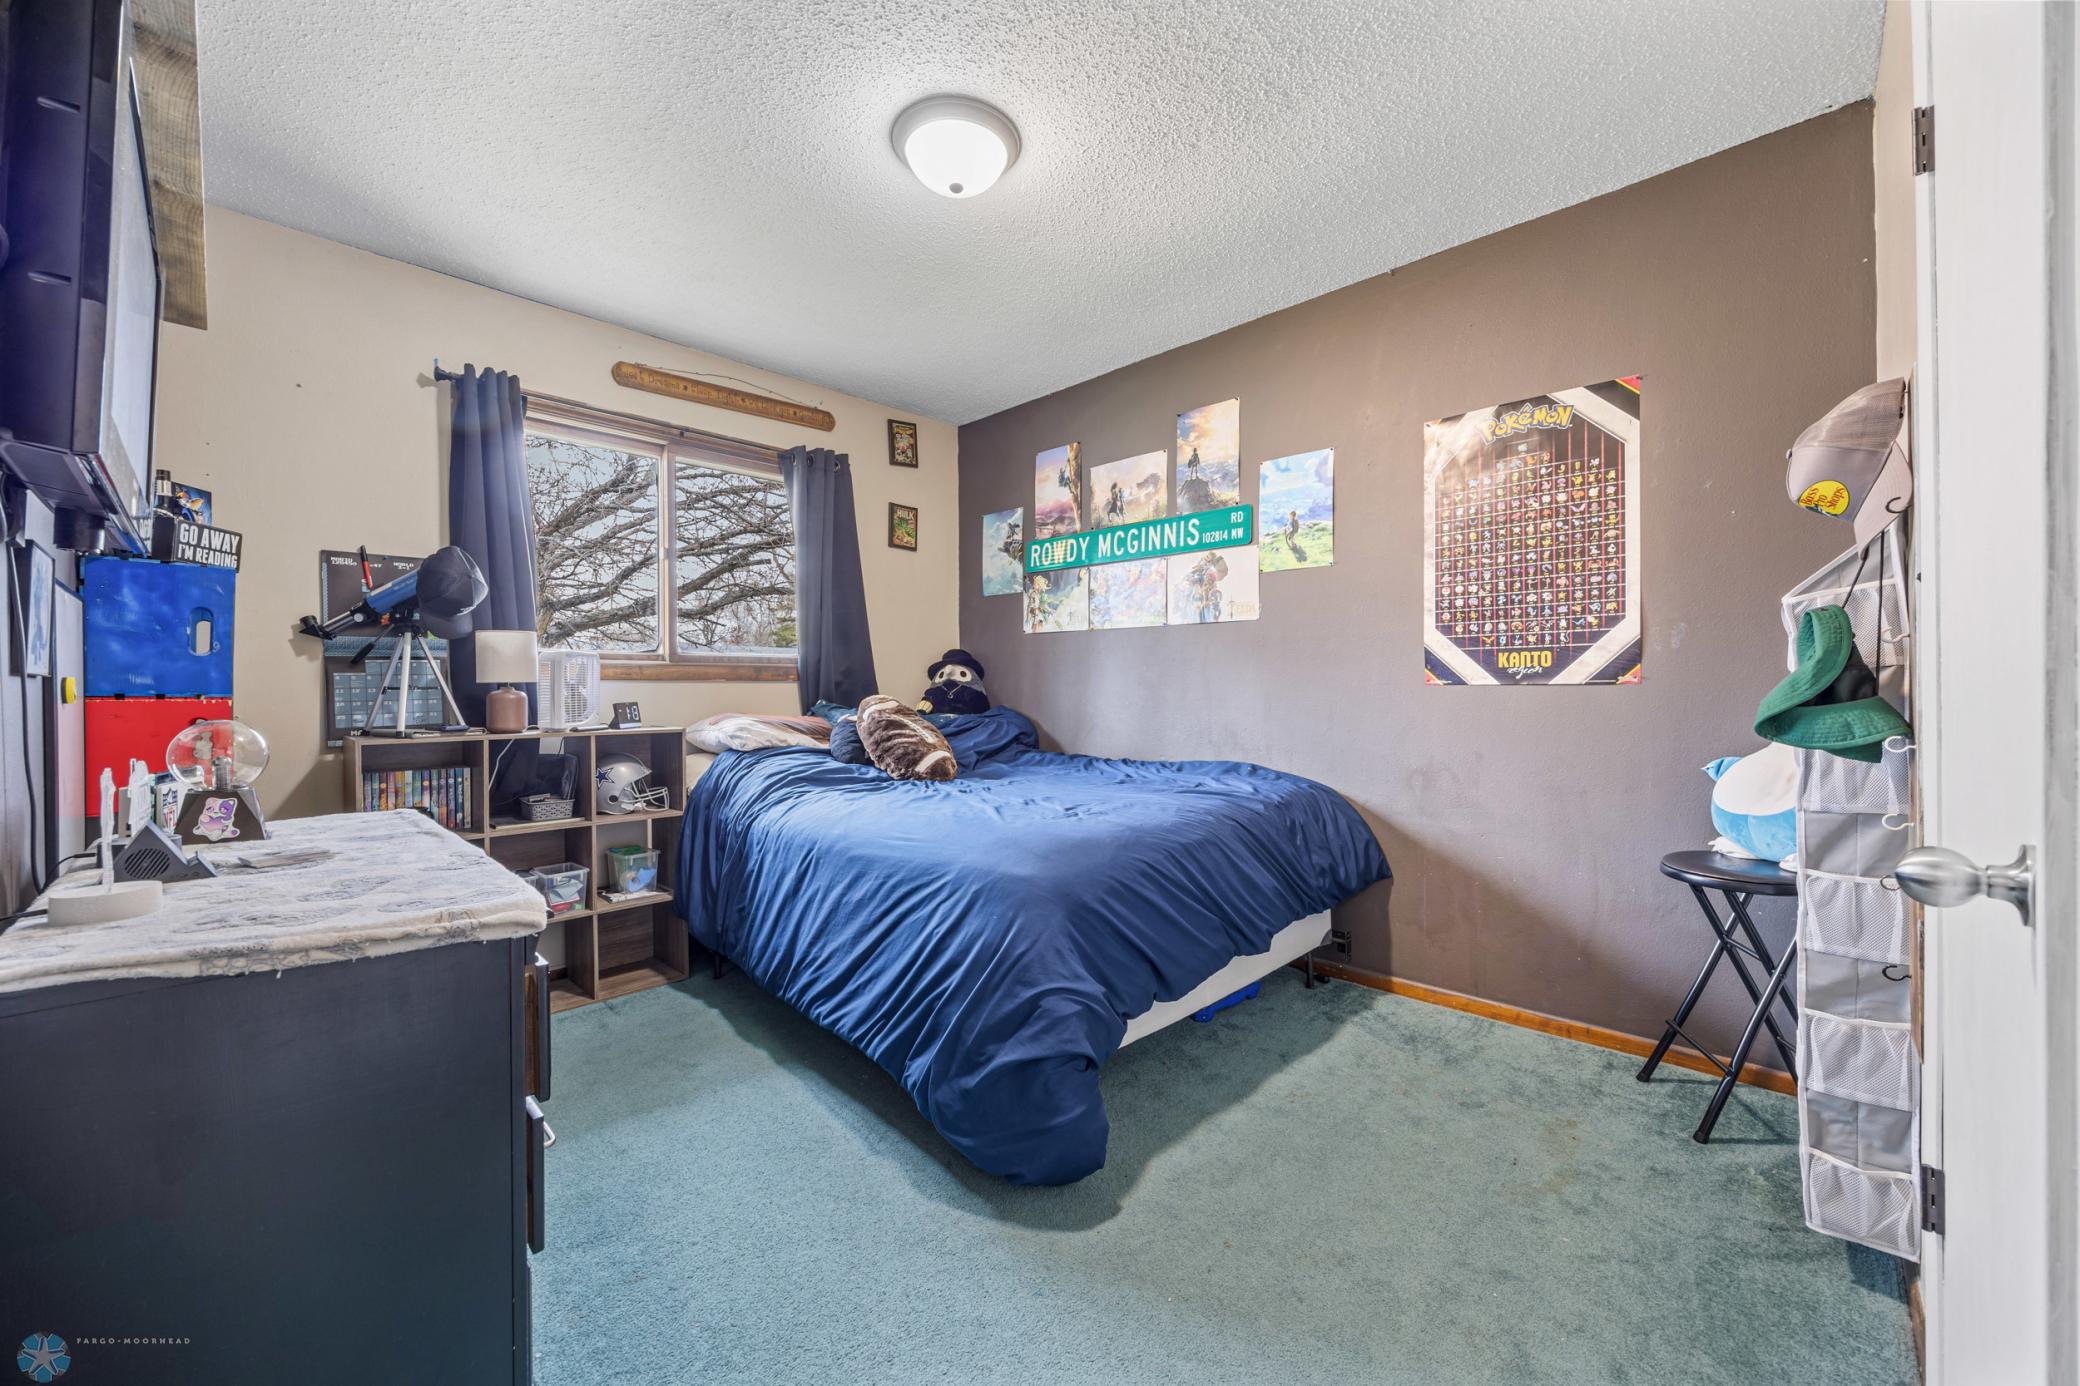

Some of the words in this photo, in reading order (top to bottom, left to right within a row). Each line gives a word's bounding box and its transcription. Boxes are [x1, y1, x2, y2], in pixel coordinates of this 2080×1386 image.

[1230, 511, 1244, 524] RD
[179, 523, 199, 546] GO
[200, 528, 240, 554] AWAY
[1030, 536, 1091, 567] ROWDY
[1097, 518, 1200, 558] MCGINNIS
[1202, 531, 1228, 544] 102814
[1231, 528, 1244, 539] NW
[177, 543, 194, 561] I'M
[195, 547, 238, 569] READING
[1498, 651, 1552, 668] KANTO
